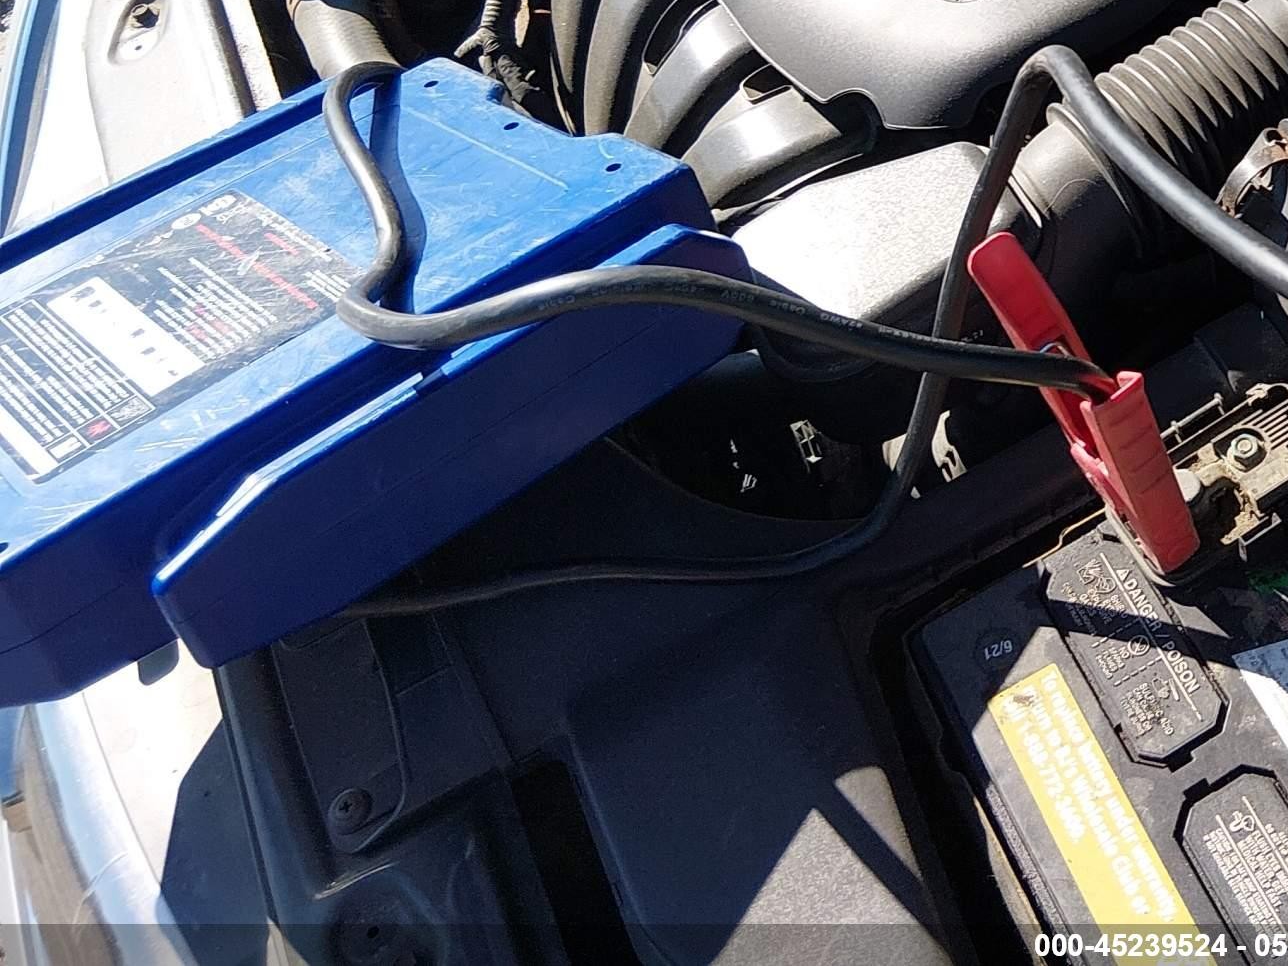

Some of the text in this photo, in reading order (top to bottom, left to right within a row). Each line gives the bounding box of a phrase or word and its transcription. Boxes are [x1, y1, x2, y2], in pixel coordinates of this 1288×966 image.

[982, 639, 1013, 660] 6/21
[1117, 645, 1130, 659] NO
[1124, 577, 1162, 631] DANGER
[1161, 639, 1199, 693] POISON
[1039, 670, 1062, 695] To
[1047, 688, 1087, 746] replace
[1073, 739, 1116, 800] battery
[1105, 793, 1141, 845] under
[1110, 852, 1144, 897] Club
